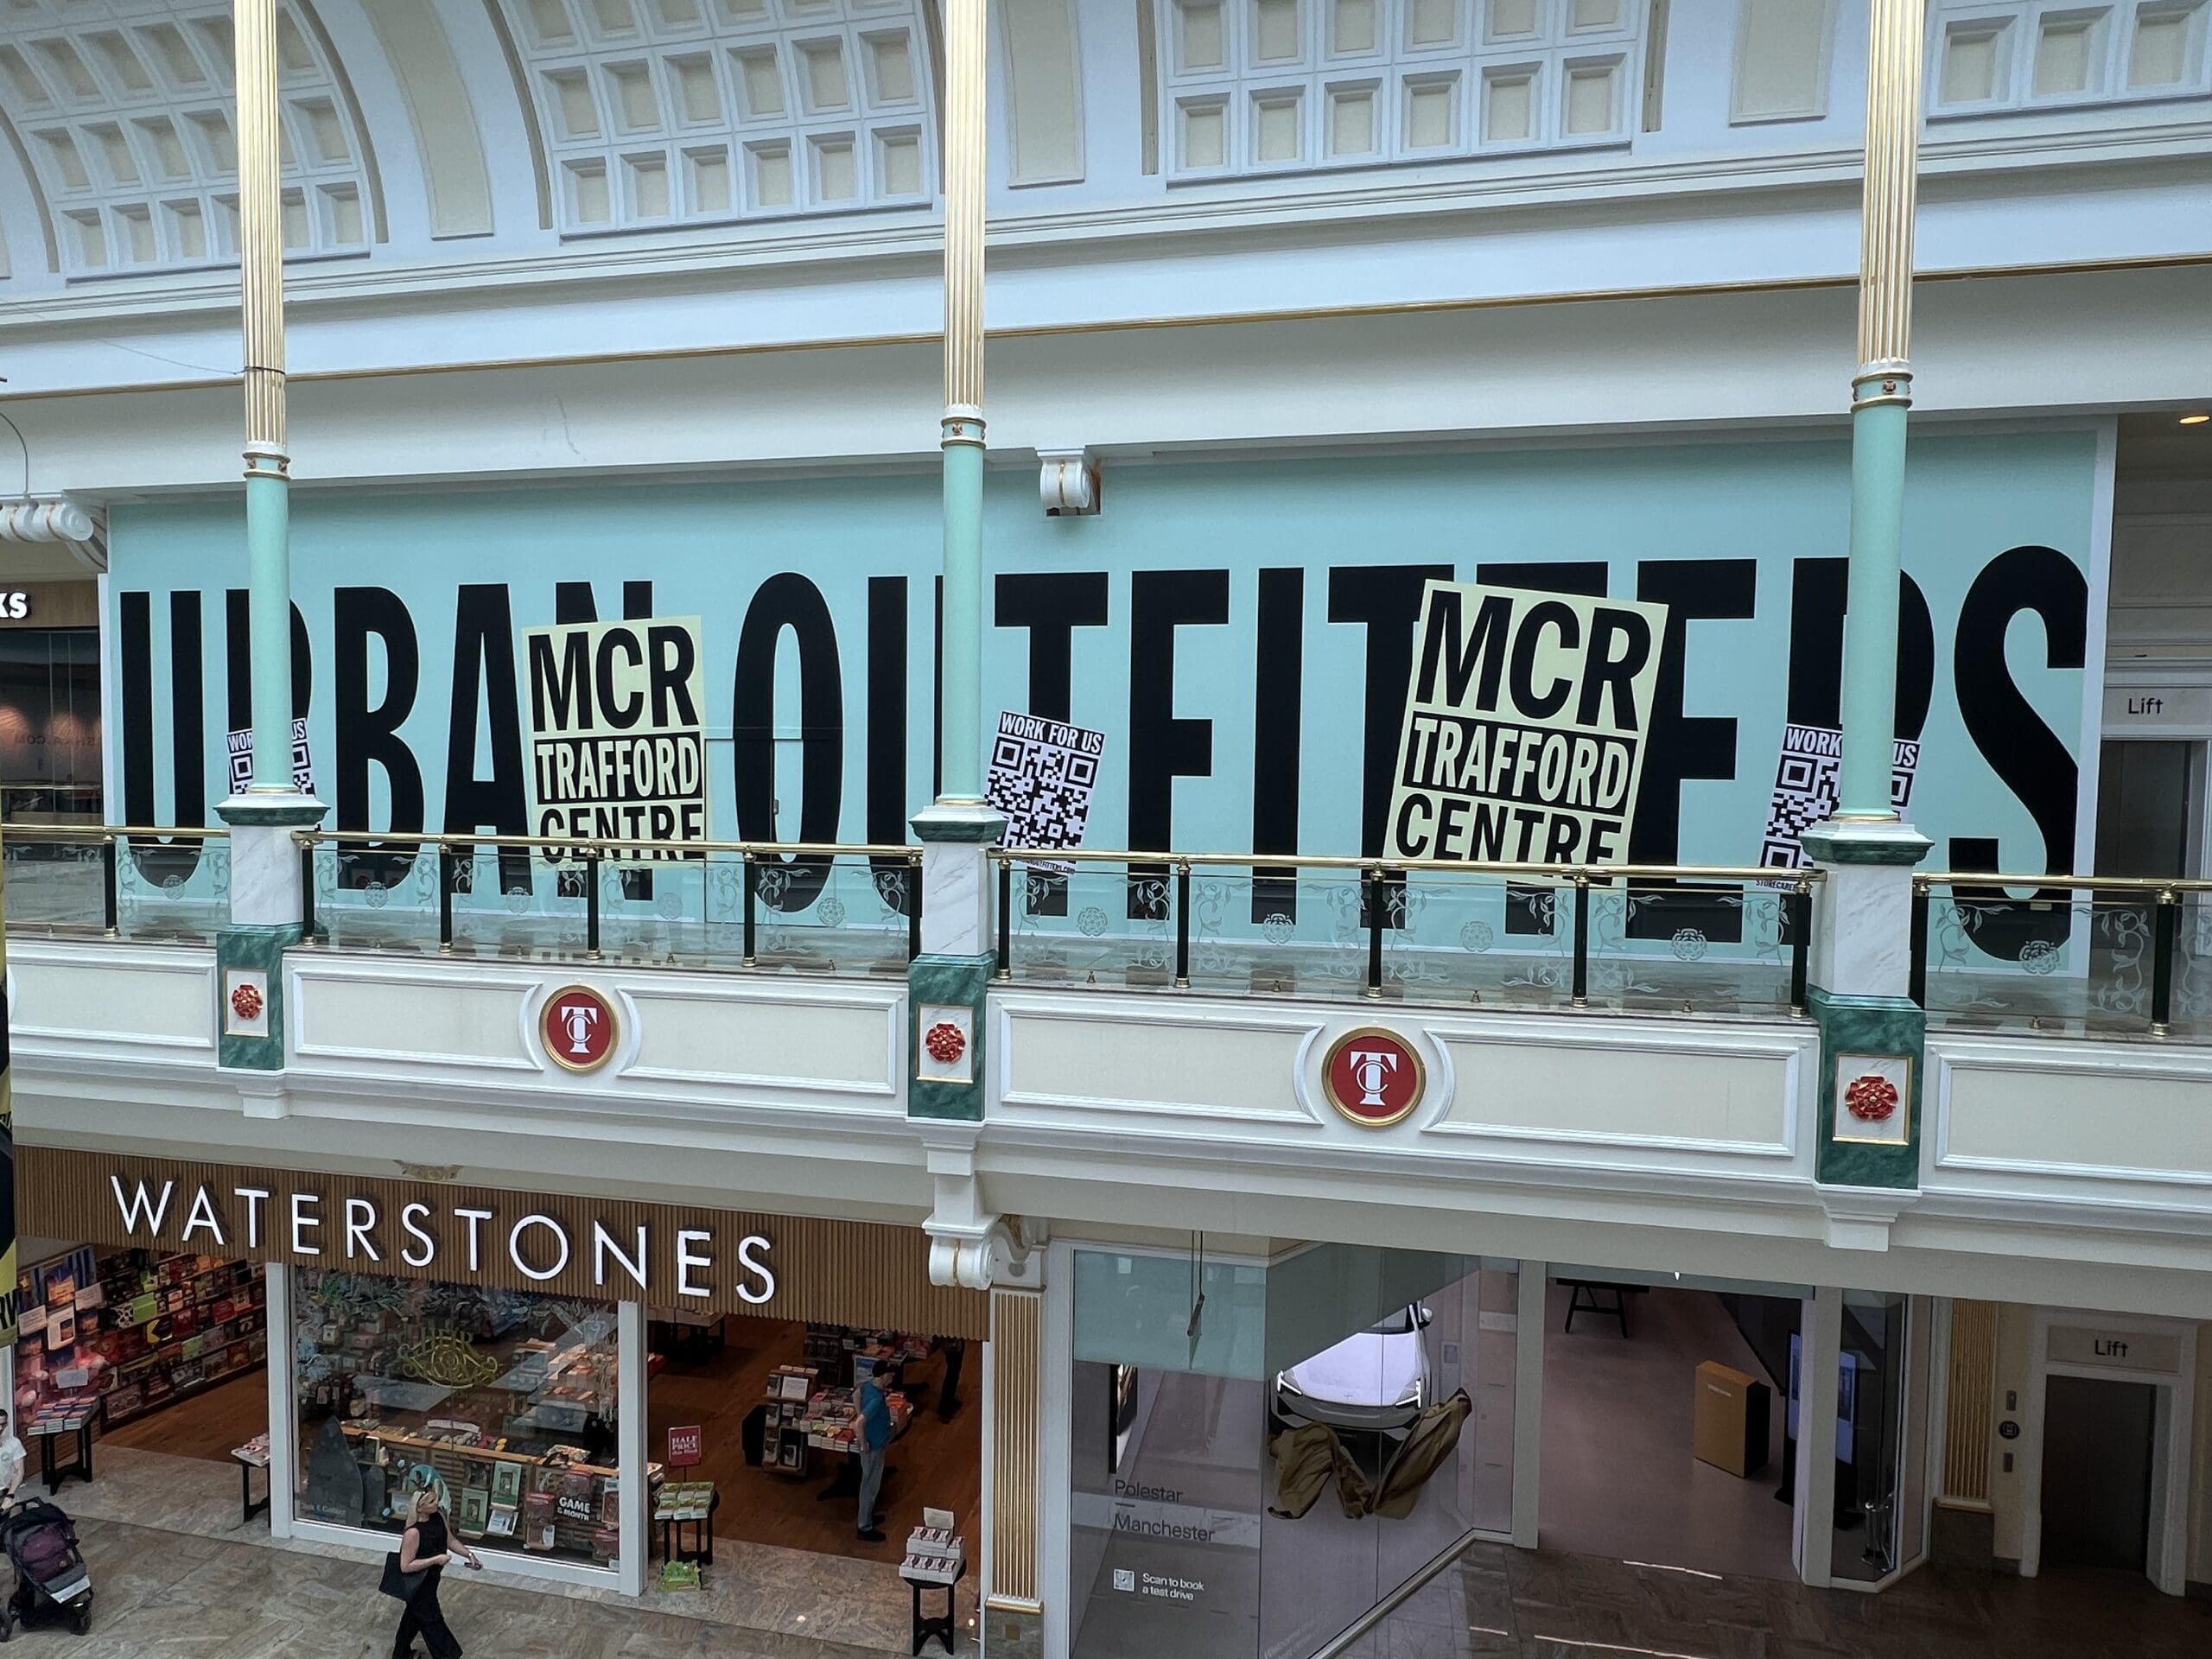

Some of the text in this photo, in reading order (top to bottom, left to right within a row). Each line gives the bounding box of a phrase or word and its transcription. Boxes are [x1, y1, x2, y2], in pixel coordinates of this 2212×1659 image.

[1415, 589, 1651, 732] MCR
[528, 625, 700, 733] MCR
[2127, 697, 2164, 715] Lift
[227, 732, 252, 752] WOR
[1001, 713, 1103, 753] WORK FOR US
[1785, 728, 1842, 757] WORK
[536, 736, 700, 800] TRAFFORD
[1412, 717, 1629, 809] TRAFFORD
[539, 804, 706, 863] CENTRE
[1395, 793, 1622, 886] CENTRE
[110, 1175, 775, 1305] WATERSTONES
[2094, 1339, 2129, 1357] Lift
[671, 1435, 698, 1445] HALF
[671, 1442, 698, 1451] PRICE
[1115, 1479, 1184, 1503] Polestar
[558, 1497, 591, 1514] GAME
[563, 1509, 590, 1522] MONTH
[1114, 1513, 1216, 1541] Manchester
[1142, 1572, 1205, 1591] Scan to book
[1150, 1587, 1168, 1597] test
[1170, 1589, 1194, 1600] drive
